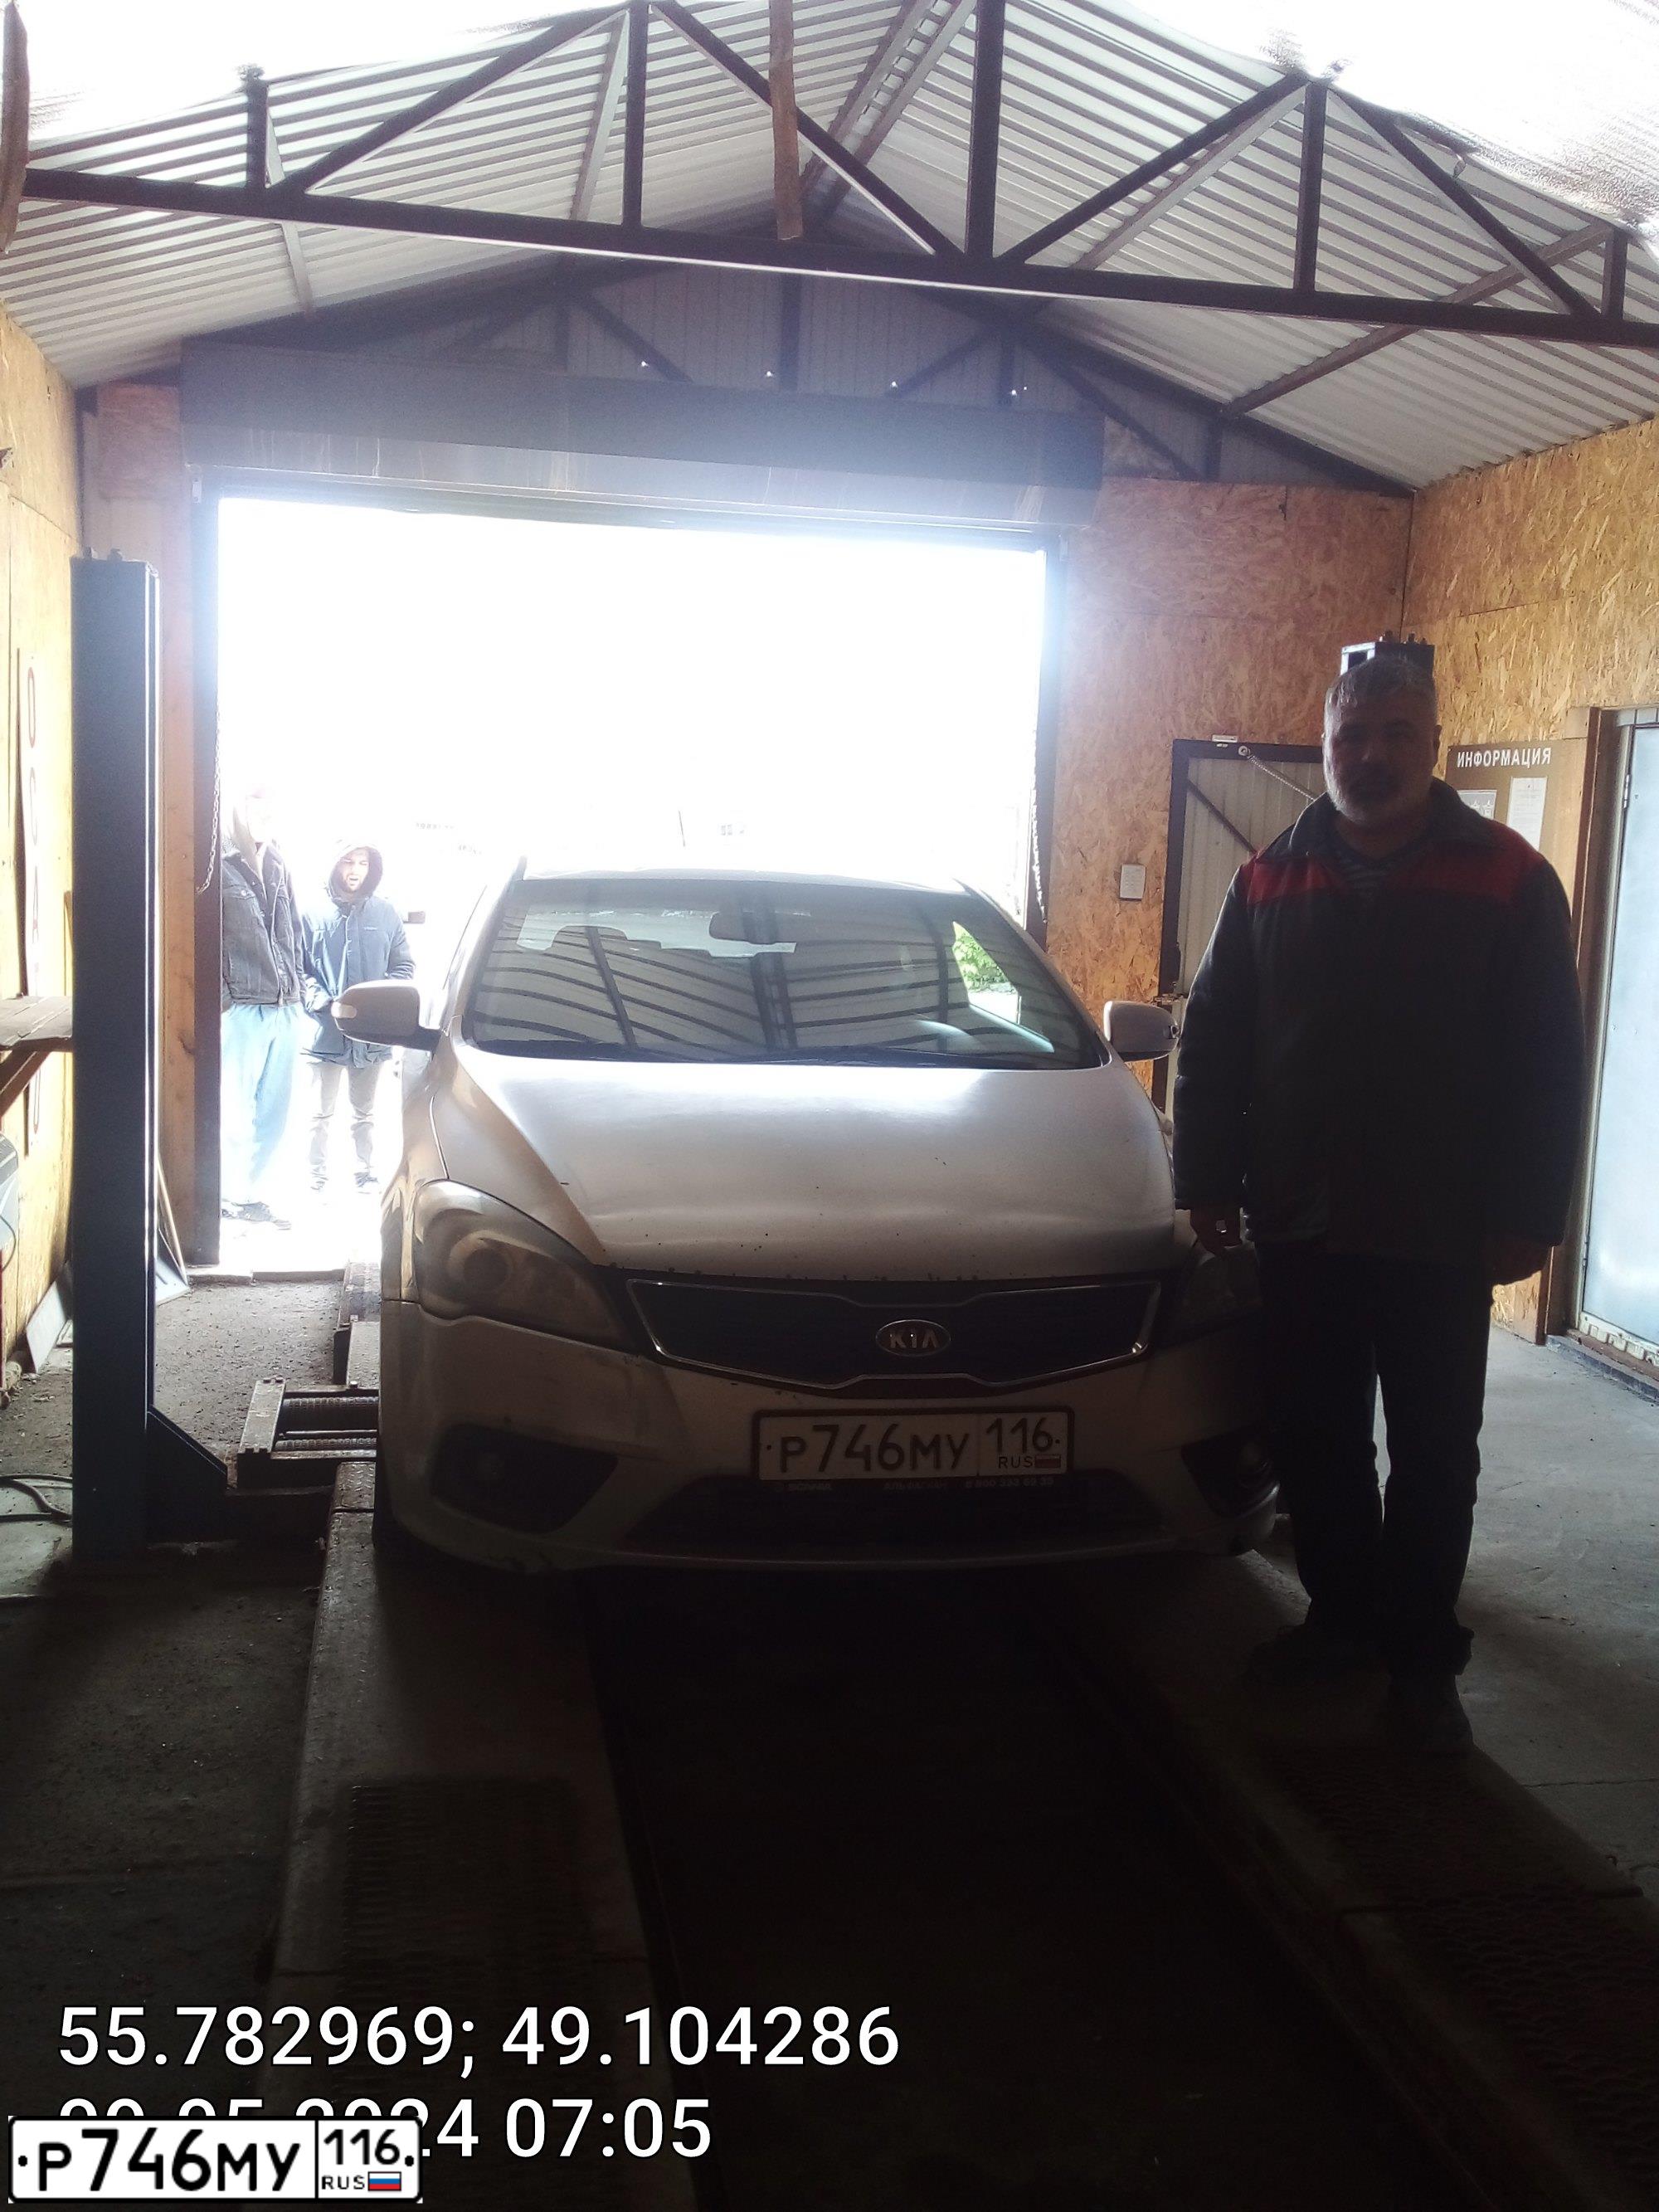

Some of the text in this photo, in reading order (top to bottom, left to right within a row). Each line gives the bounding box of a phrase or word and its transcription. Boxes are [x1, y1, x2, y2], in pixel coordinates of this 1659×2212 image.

[1457, 748, 1551, 768] ИНФОРМАЦИЯ
[889, 1330, 940, 1349] KIA
[986, 1417, 1053, 1453] 116
[999, 1456, 1033, 1469] RUS
